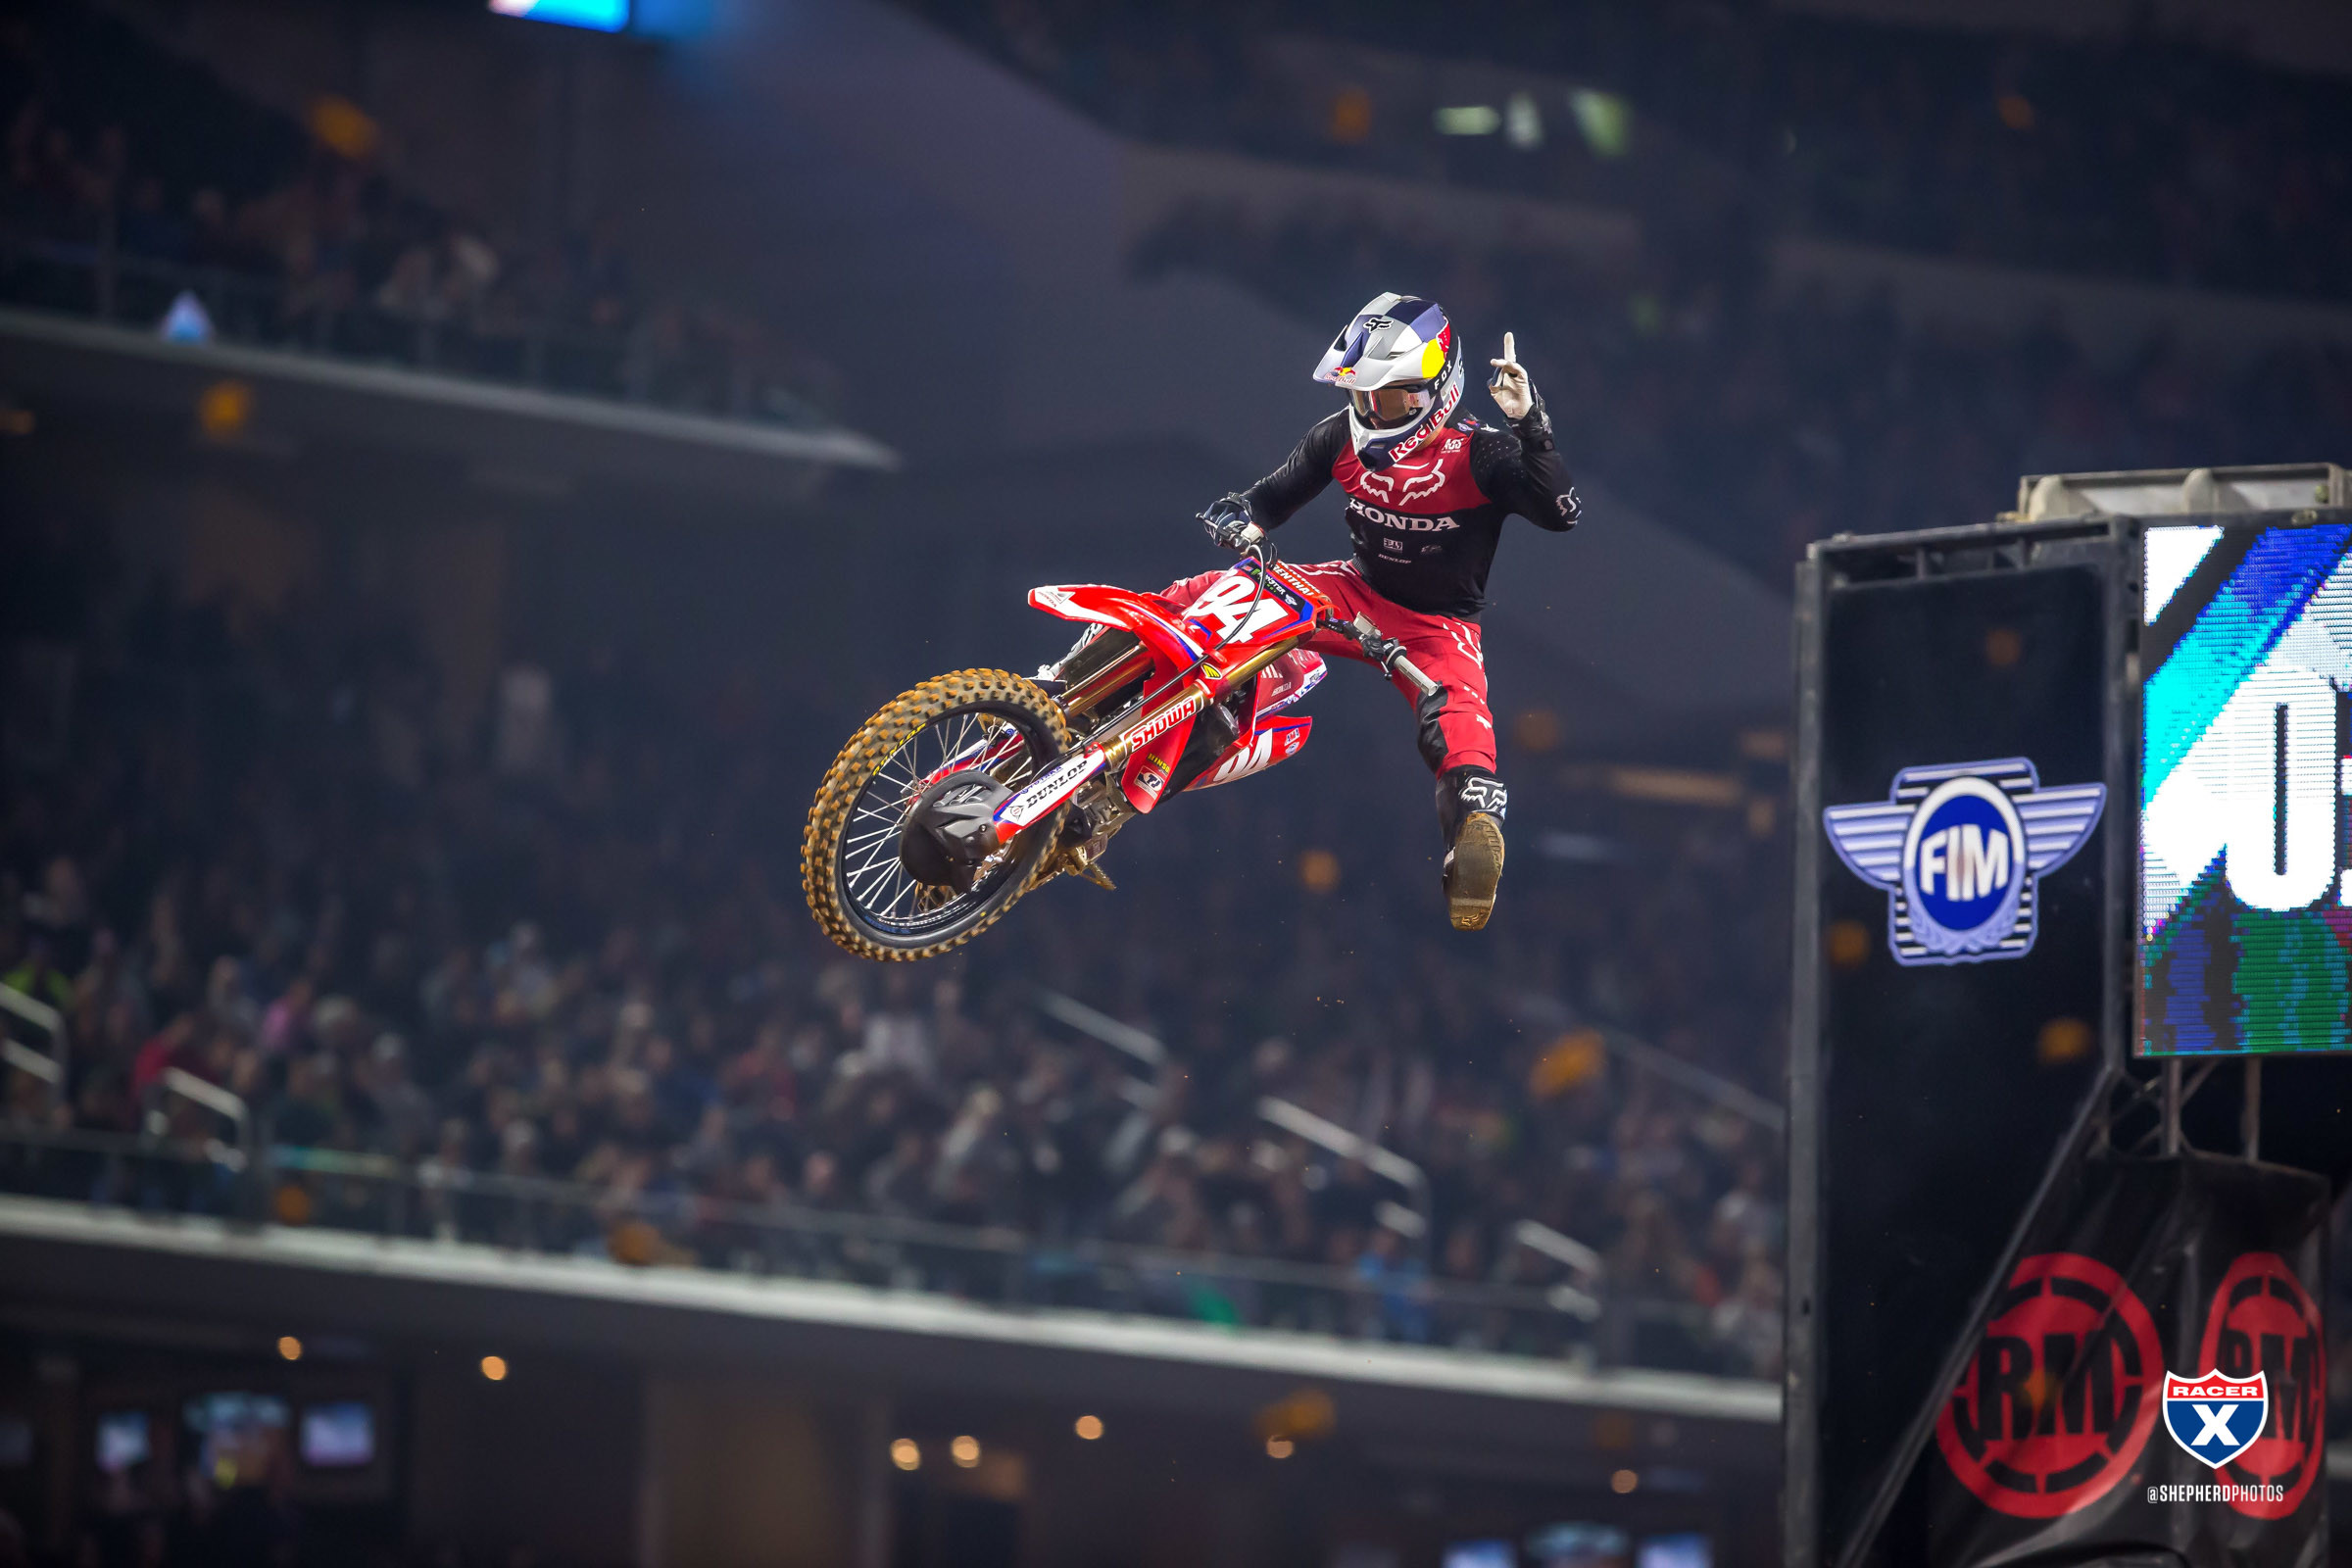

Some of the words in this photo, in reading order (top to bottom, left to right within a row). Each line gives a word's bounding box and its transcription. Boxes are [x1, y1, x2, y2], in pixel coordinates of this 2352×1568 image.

[1434, 360, 1452, 390] FOX
[1389, 417, 1432, 461] Red
[1431, 383, 1459, 428] Bull
[1346, 498, 1460, 531] HONDA
[1182, 575, 1289, 644] 94
[1132, 697, 1196, 752] SHOWA
[1026, 760, 1088, 808] DUNLOP
[1920, 824, 2009, 901] FIM
[1976, 1333, 2115, 1442] RM
